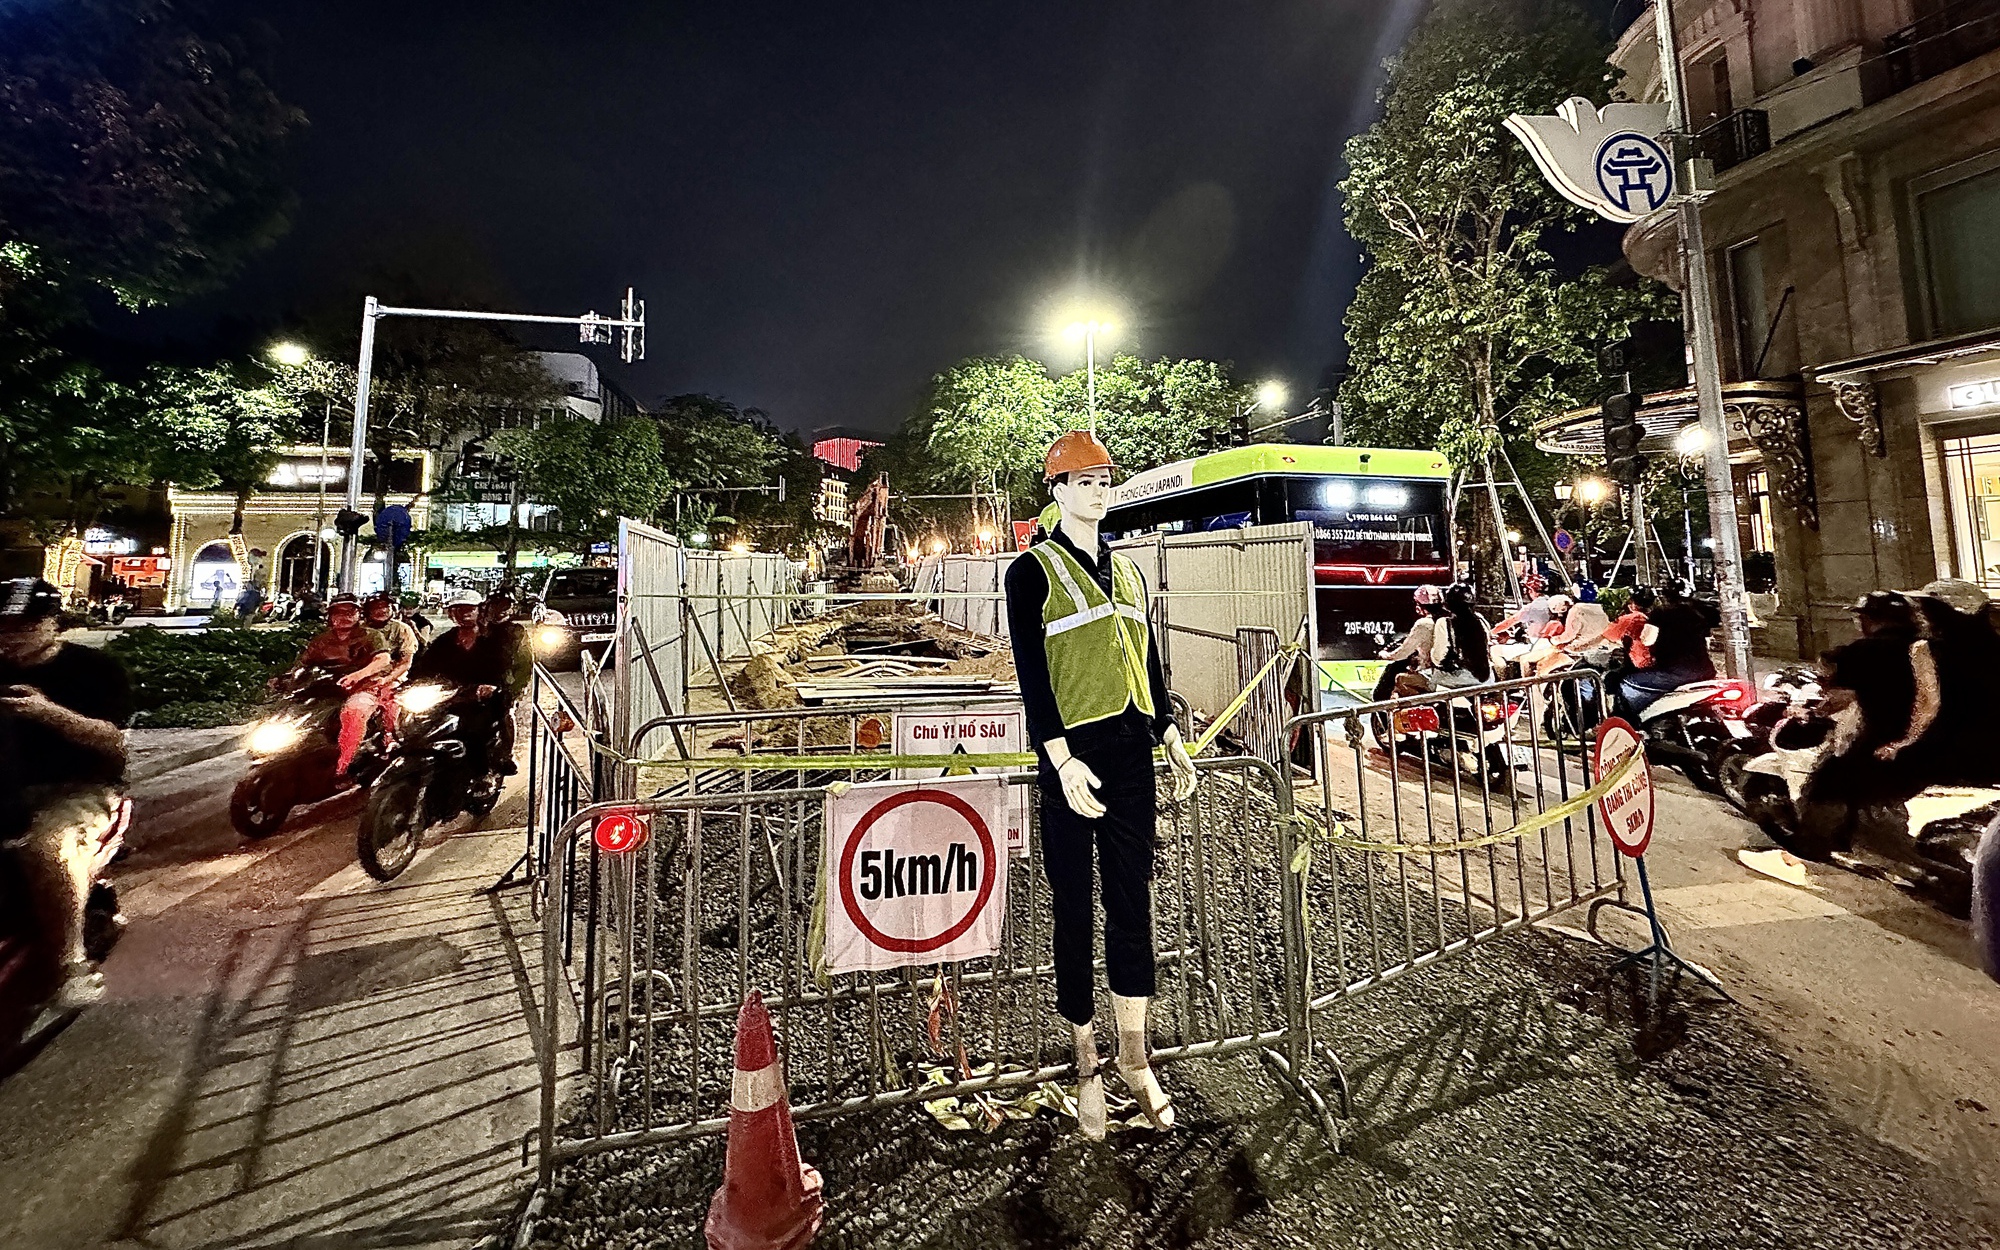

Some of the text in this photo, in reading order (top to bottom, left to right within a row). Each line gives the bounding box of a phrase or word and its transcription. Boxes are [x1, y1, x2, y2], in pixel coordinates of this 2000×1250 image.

[1331, 529, 1344, 540] 355
[1344, 529, 1355, 540] 222
[913, 724, 939, 739] Chú
[959, 719, 976, 738] HỐ
[980, 721, 1006, 738] SÂU
[860, 842, 977, 901] 5km/h
